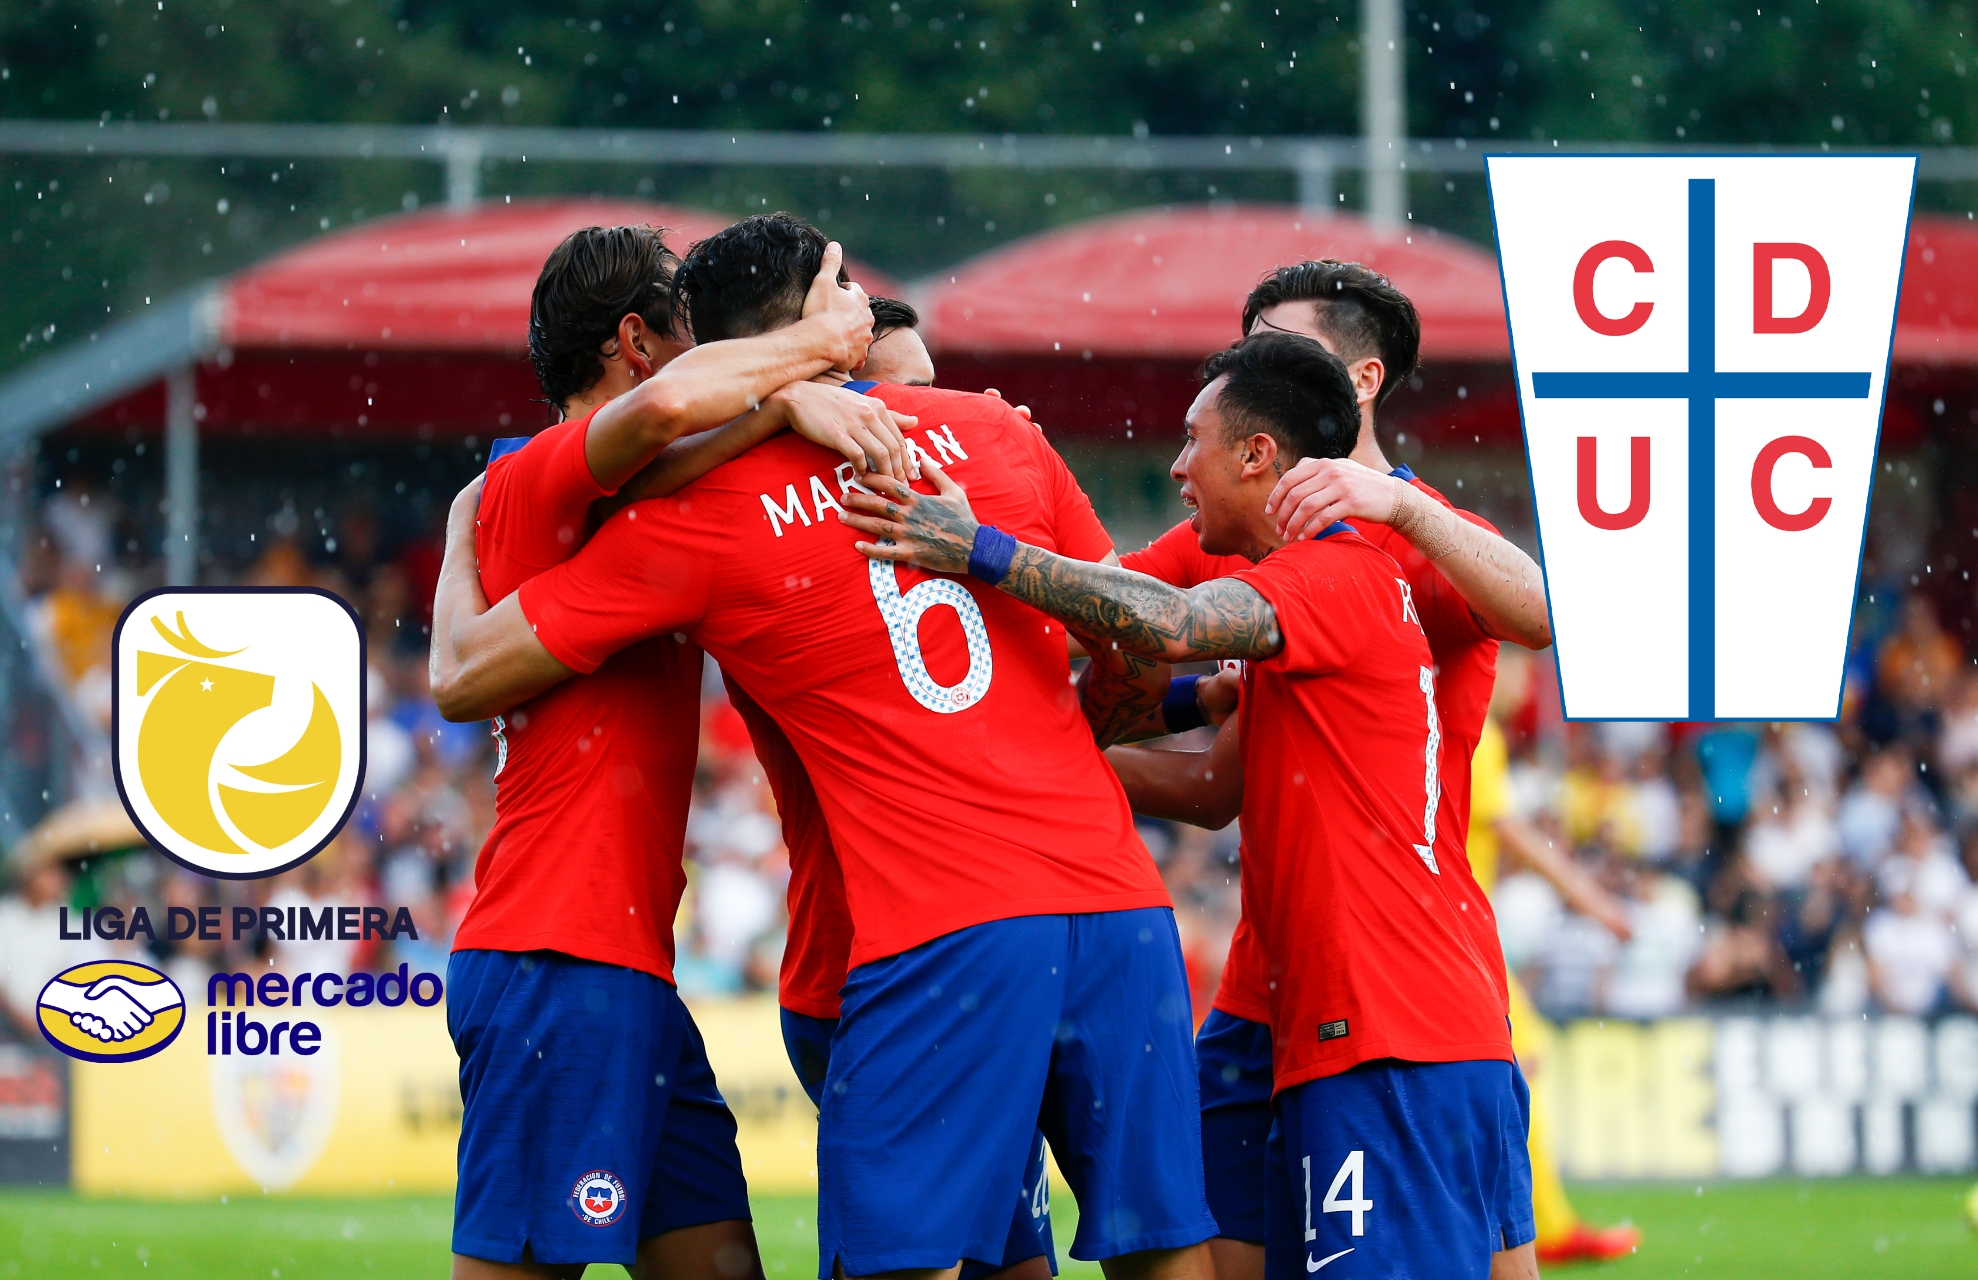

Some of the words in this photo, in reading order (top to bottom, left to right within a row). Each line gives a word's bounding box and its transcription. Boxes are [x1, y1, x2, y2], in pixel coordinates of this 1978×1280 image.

[868, 534, 993, 714] 6
[573, 1172, 601, 1198] FEDERACION
[604, 1173, 612, 1182] DE
[613, 1180, 626, 1202] FUTBOL
[1302, 1150, 1374, 1243] 14
[584, 1215, 592, 1223] DE
[594, 1217, 611, 1225] CHILE
